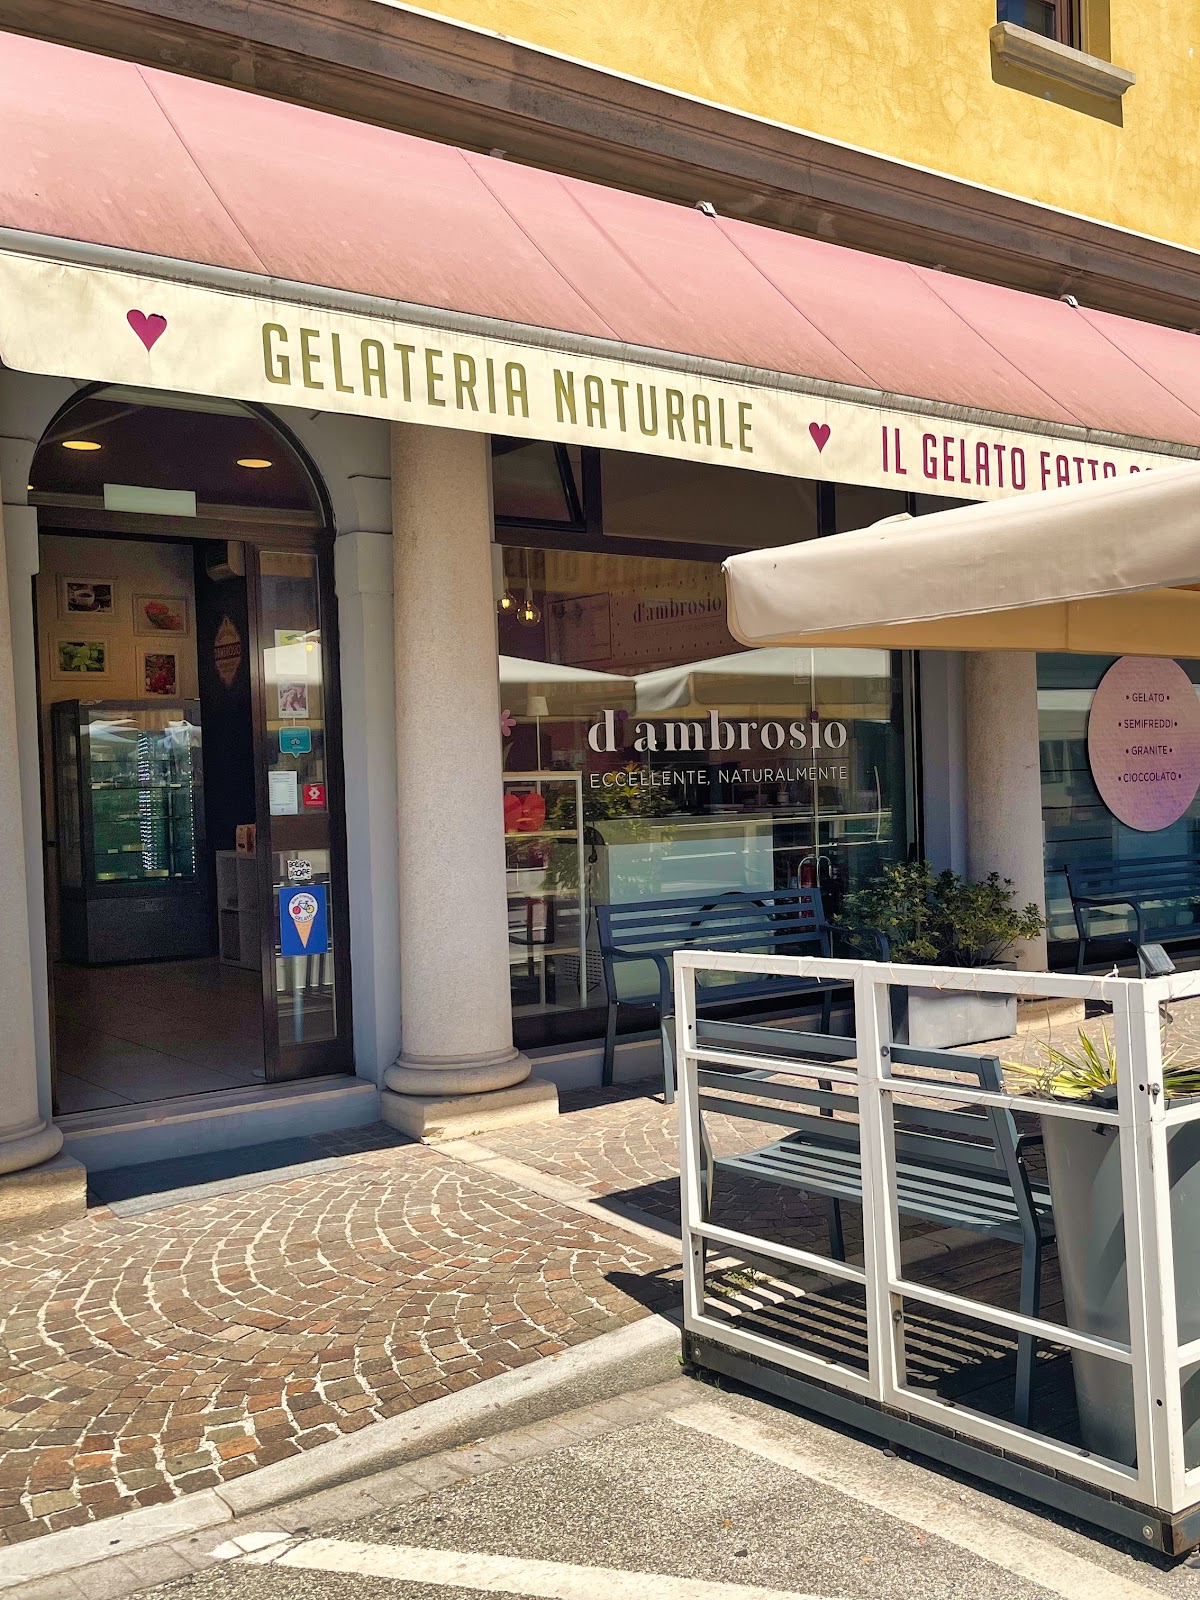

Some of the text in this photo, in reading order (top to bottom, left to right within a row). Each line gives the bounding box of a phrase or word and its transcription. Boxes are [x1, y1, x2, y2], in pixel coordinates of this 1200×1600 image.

[262, 322, 753, 453] GELATERIA NATURALE
[882, 425, 907, 475] IL
[922, 433, 1026, 491] GELATO
[633, 591, 722, 624] d'ambrosio
[1132, 692, 1165, 702] GELATO
[1124, 719, 1174, 729] SEMIFREDDI
[1131, 745, 1168, 755] GRANITE
[590, 766, 847, 789] ECCELLENTE, NATURALMENTE
[1123, 771, 1177, 782] CIOCCOLATO
